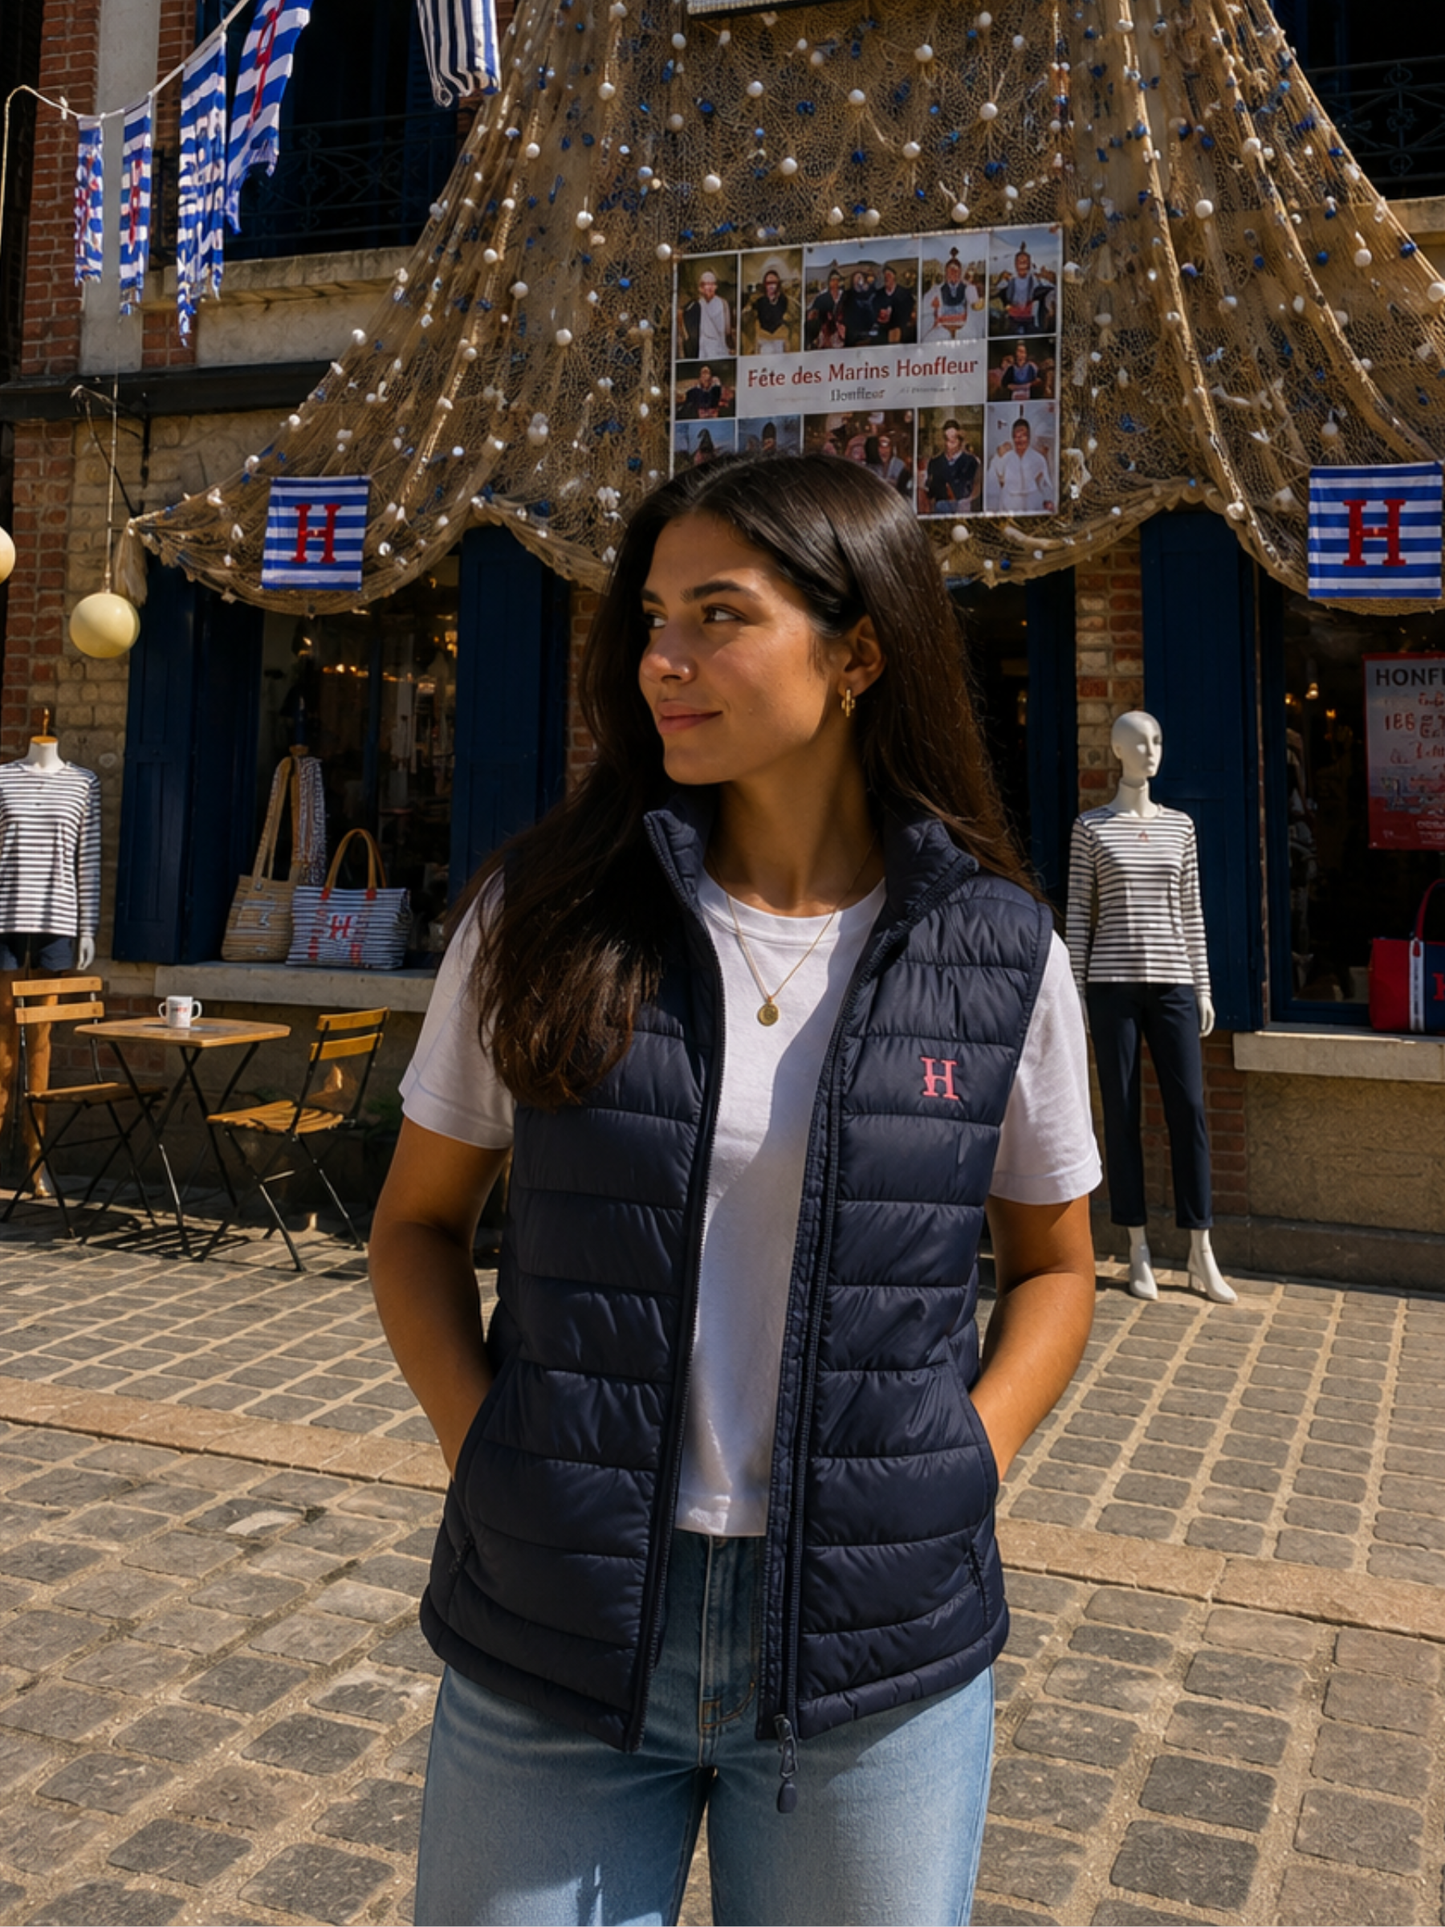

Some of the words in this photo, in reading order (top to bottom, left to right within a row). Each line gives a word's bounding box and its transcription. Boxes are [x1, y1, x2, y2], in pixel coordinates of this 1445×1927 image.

[747, 367, 786, 387] Fête
[791, 366, 822, 385] des
[828, 362, 890, 382] Marins
[896, 356, 979, 378] Honfleur
[290, 503, 342, 564] H
[1342, 499, 1407, 567] H
[1376, 667, 1445, 687] HONF
[329, 914, 353, 939] H
[920, 1056, 960, 1101] H
